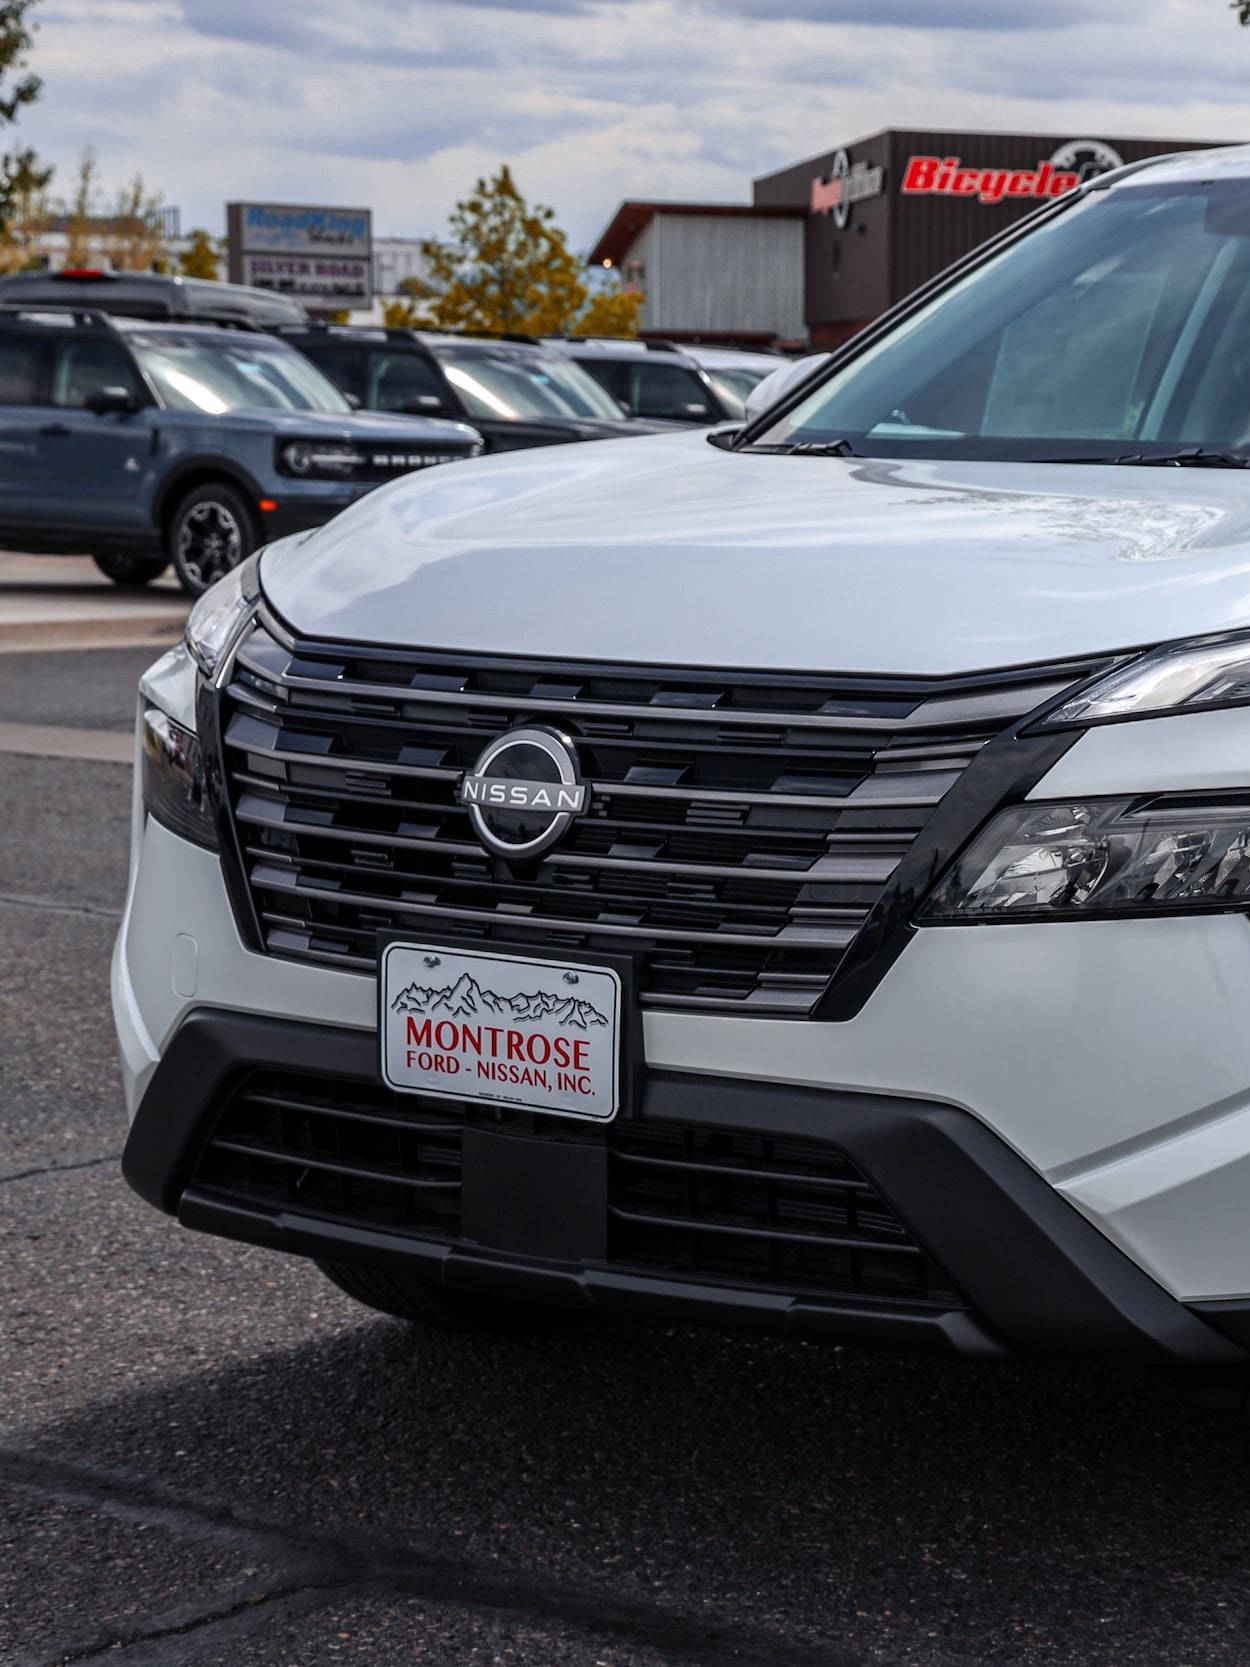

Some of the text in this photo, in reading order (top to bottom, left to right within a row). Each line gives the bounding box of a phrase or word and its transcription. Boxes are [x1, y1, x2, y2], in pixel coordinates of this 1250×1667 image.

[902, 157, 1081, 205] Bicycle
[463, 781, 580, 808] NISSAN
[406, 1016, 591, 1071] MONTROSE
[406, 1050, 460, 1075] FORD
[477, 1060, 552, 1093] NISSAN,
[557, 1072, 596, 1097] INC.
